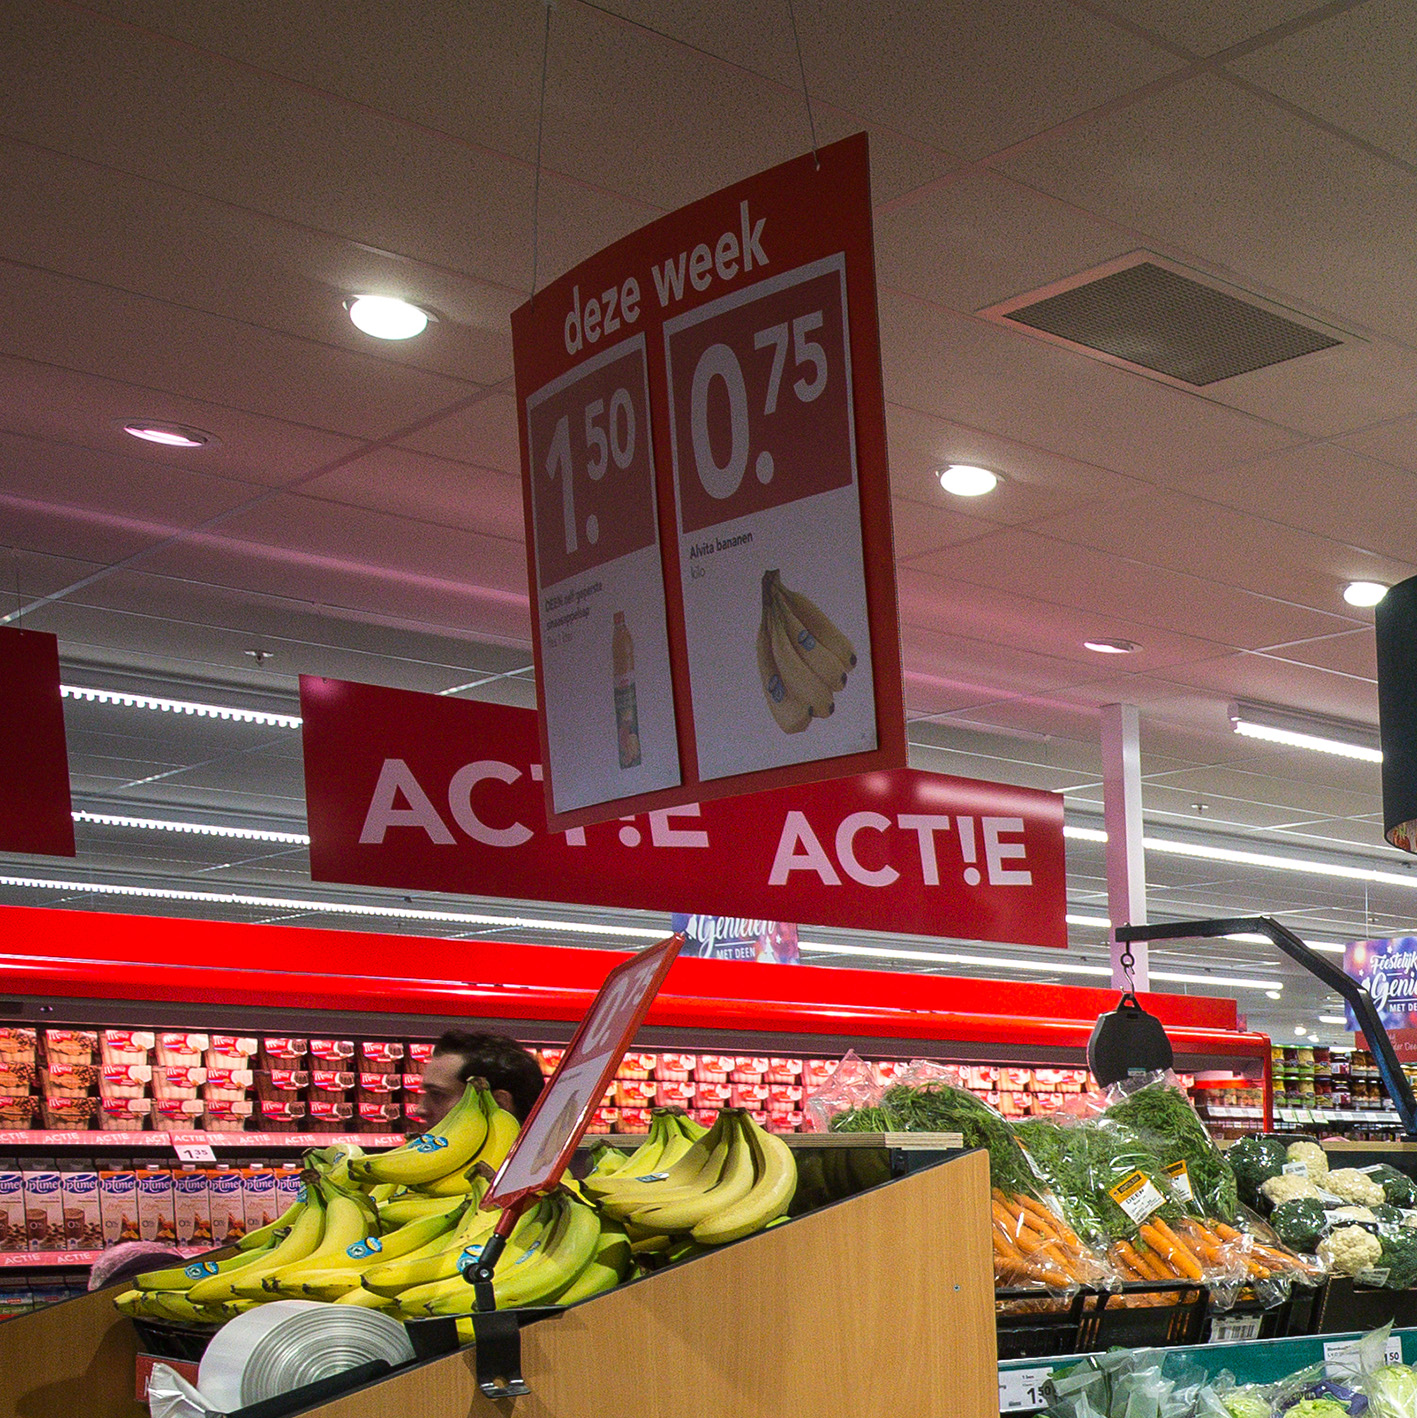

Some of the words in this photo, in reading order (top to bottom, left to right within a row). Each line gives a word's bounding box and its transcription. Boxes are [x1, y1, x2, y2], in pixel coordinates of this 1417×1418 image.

[564, 284, 641, 355] deze
[651, 200, 771, 308] week
[690, 310, 828, 501] 0.75
[545, 387, 636, 555] 1.50
[716, 532, 753, 551] bananen
[717, 949, 735, 959] MET
[735, 947, 756, 959] DEEN
[1389, 1004, 1405, 1012] MET
[184, 1149, 208, 1159] 1.35
[1126, 1189, 1144, 1205] DEEN
[1384, 1352, 1400, 1366] 150
